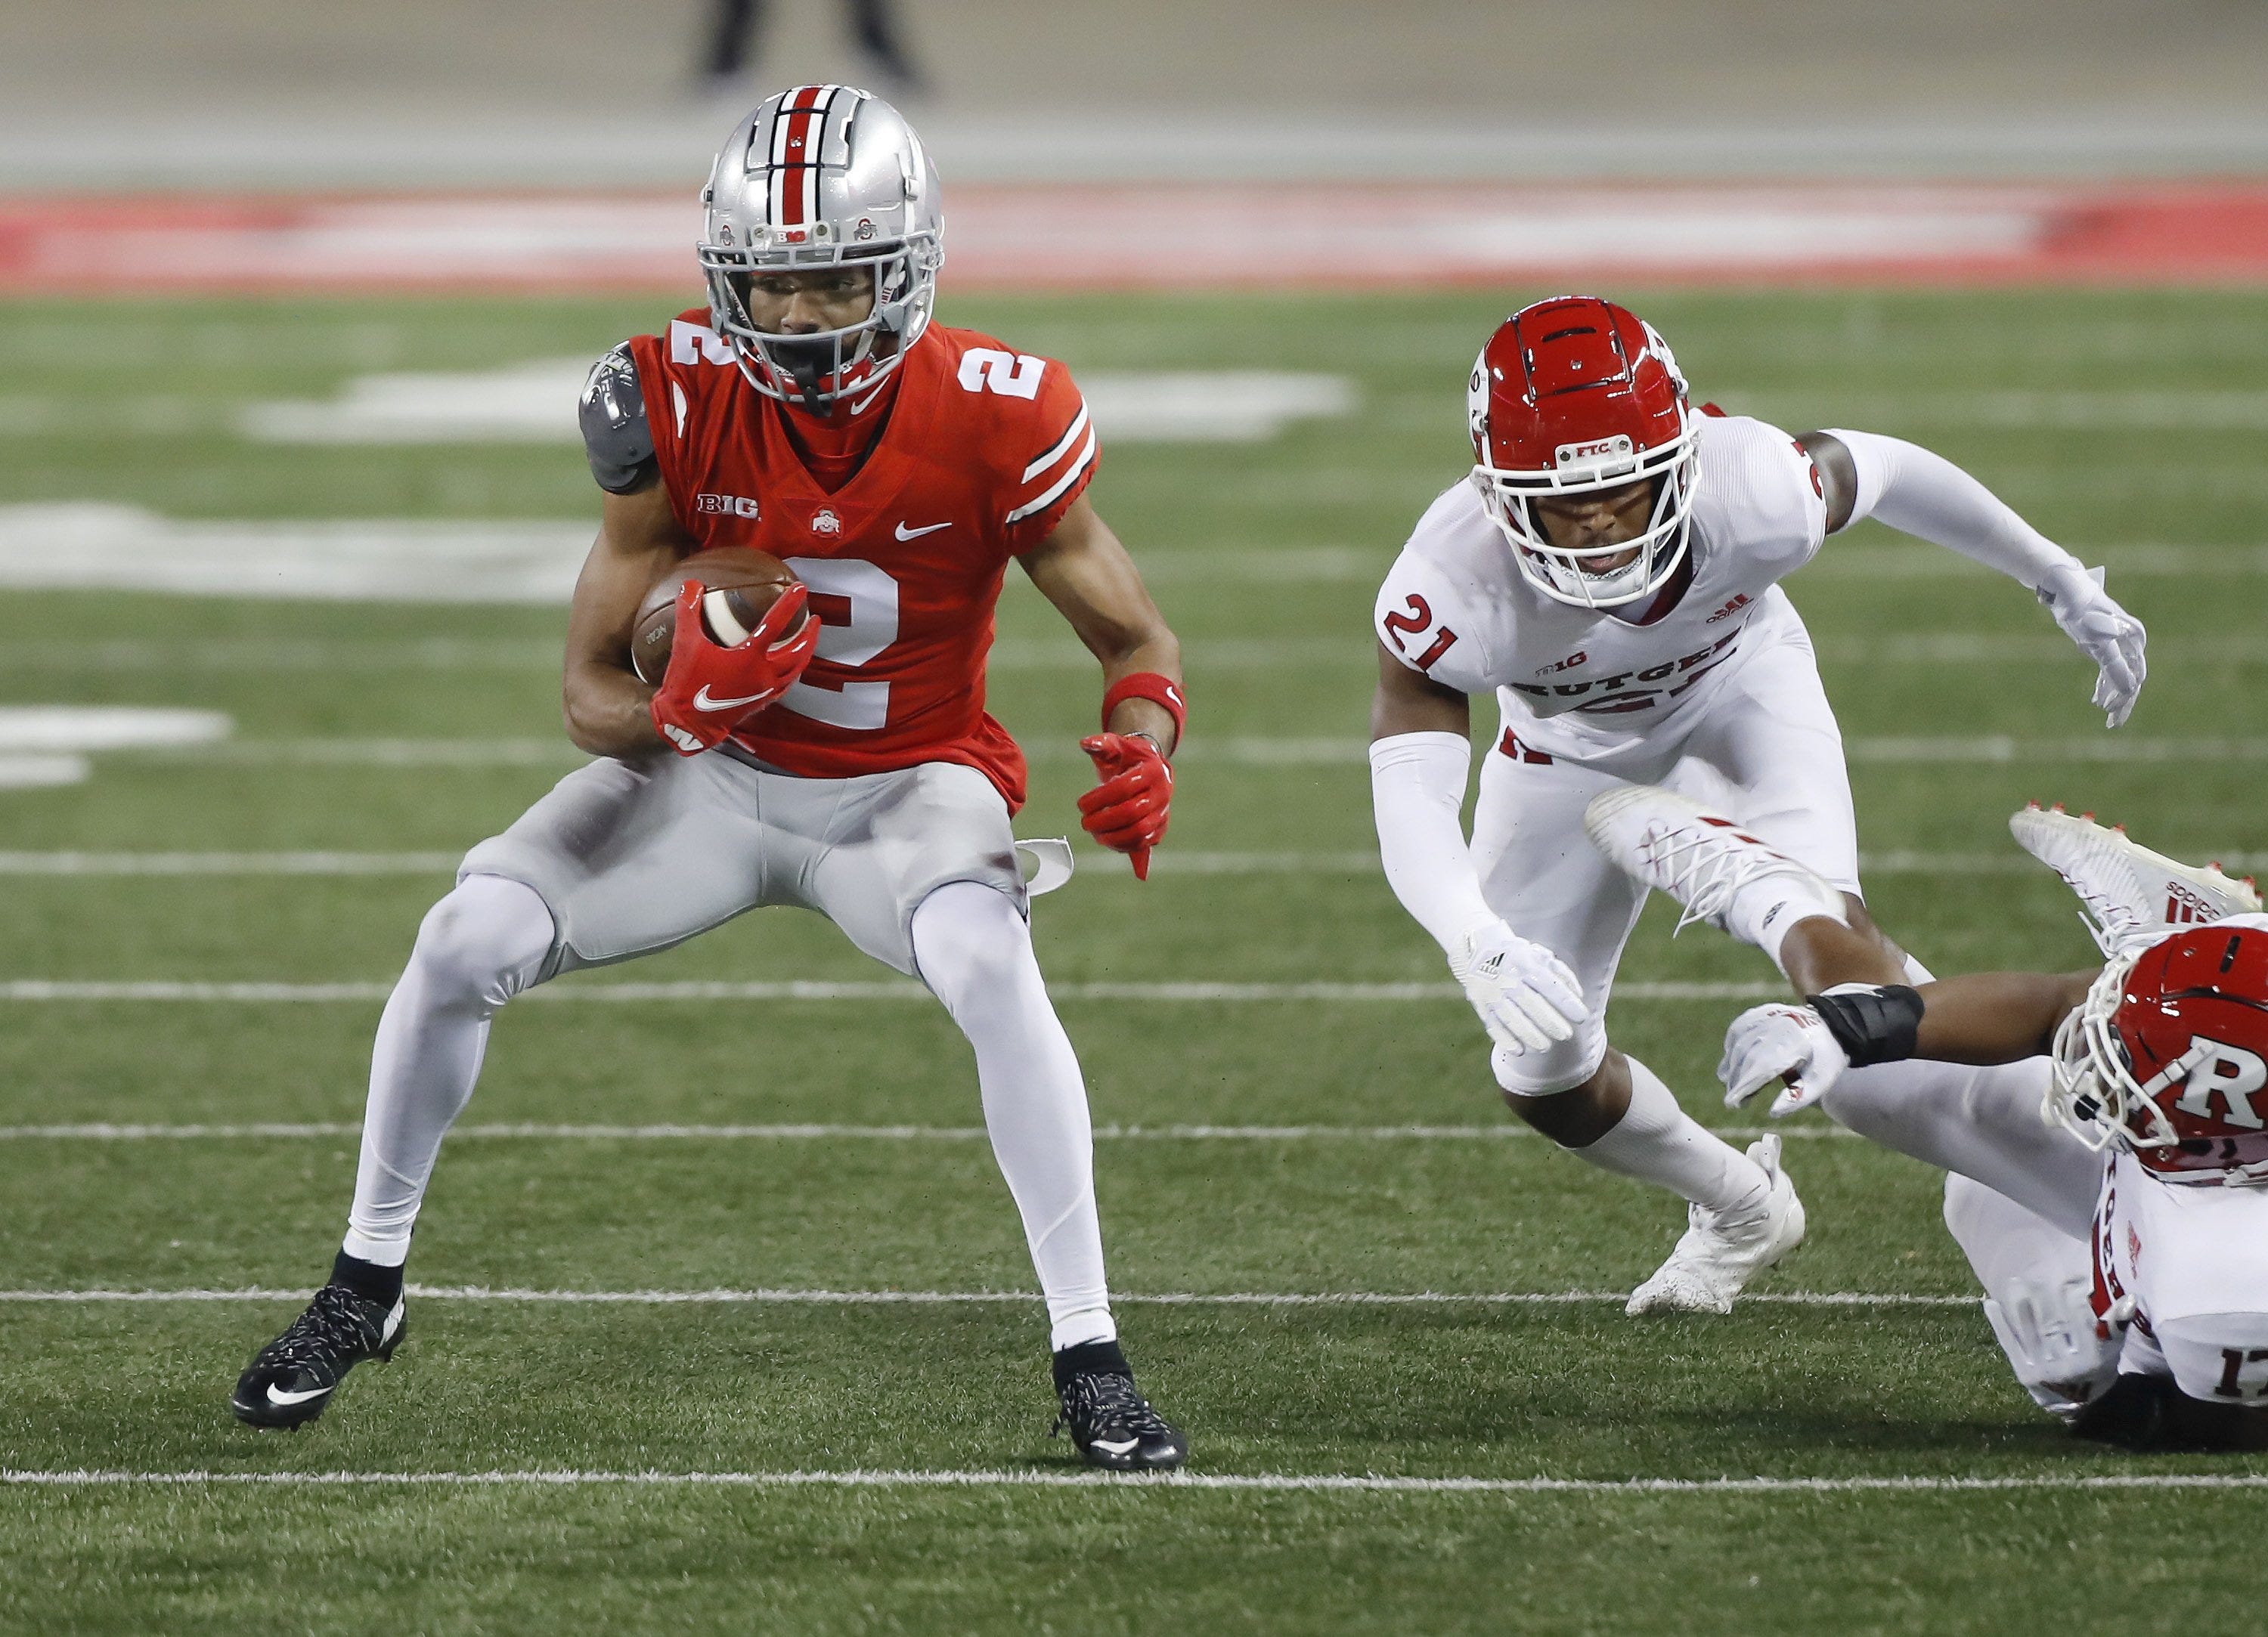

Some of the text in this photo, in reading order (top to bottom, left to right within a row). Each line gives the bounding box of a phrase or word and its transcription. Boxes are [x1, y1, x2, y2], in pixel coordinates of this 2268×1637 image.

[671, 319, 738, 366] 2
[957, 347, 1046, 401] 2
[777, 557, 899, 730] 2
[1383, 594, 1459, 675] 21
[2166, 881, 2220, 921] adidas
[2175, 1034, 2268, 1130] R
